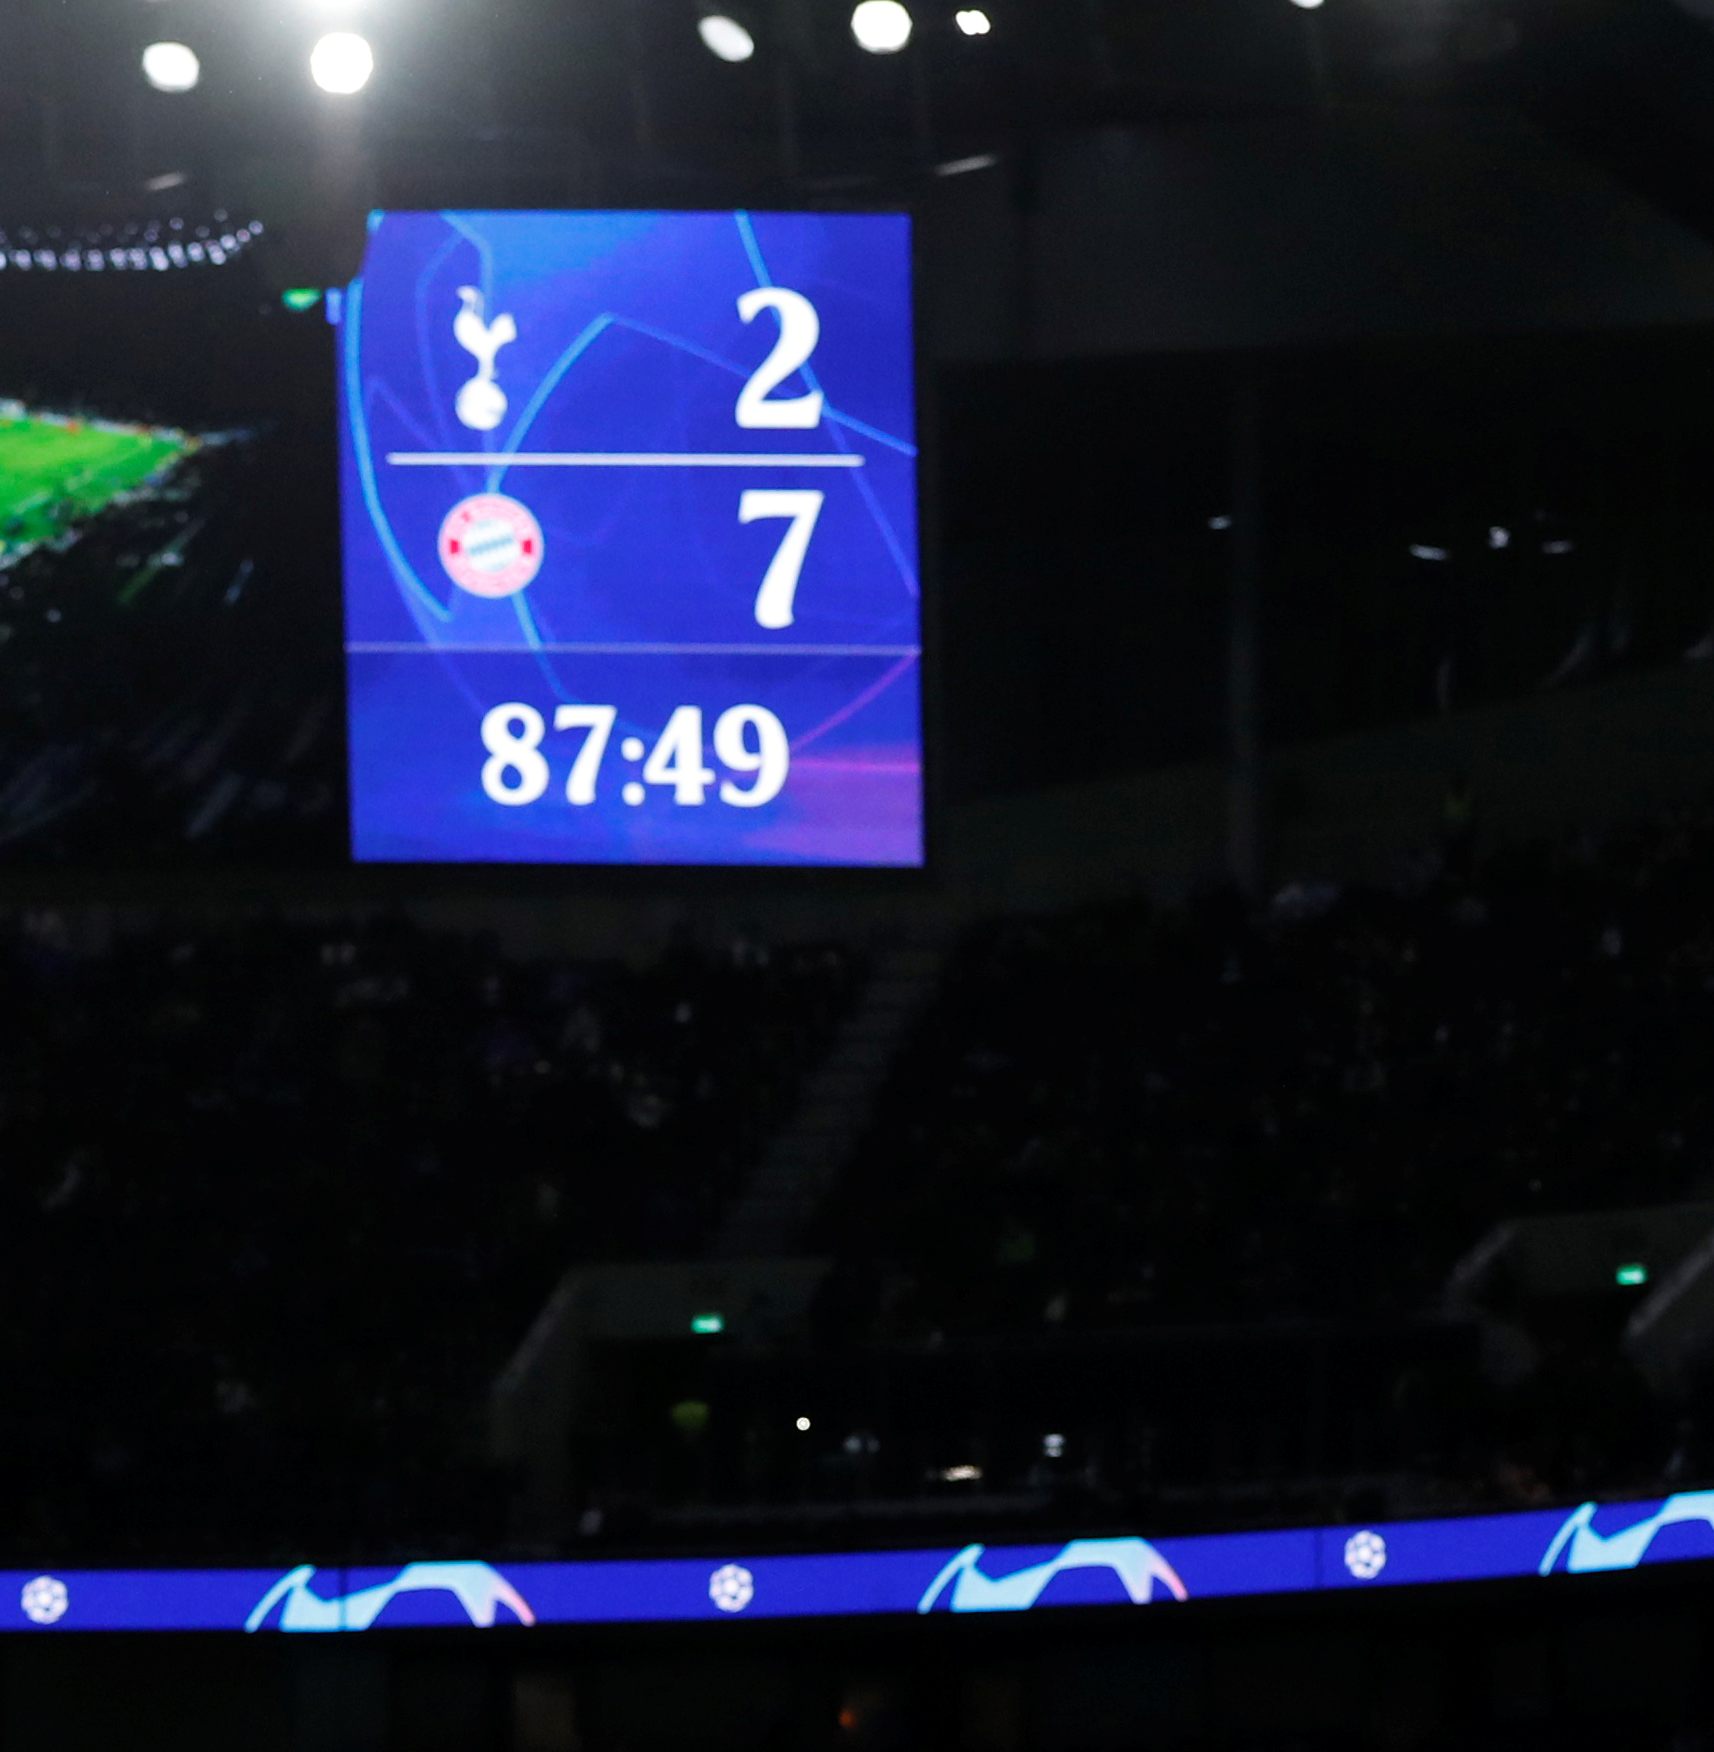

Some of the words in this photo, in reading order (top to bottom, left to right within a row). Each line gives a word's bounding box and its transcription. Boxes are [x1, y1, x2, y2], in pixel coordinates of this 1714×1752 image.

[735, 287, 823, 428] 2
[738, 490, 824, 629] 7
[481, 702, 788, 807] 87:49
